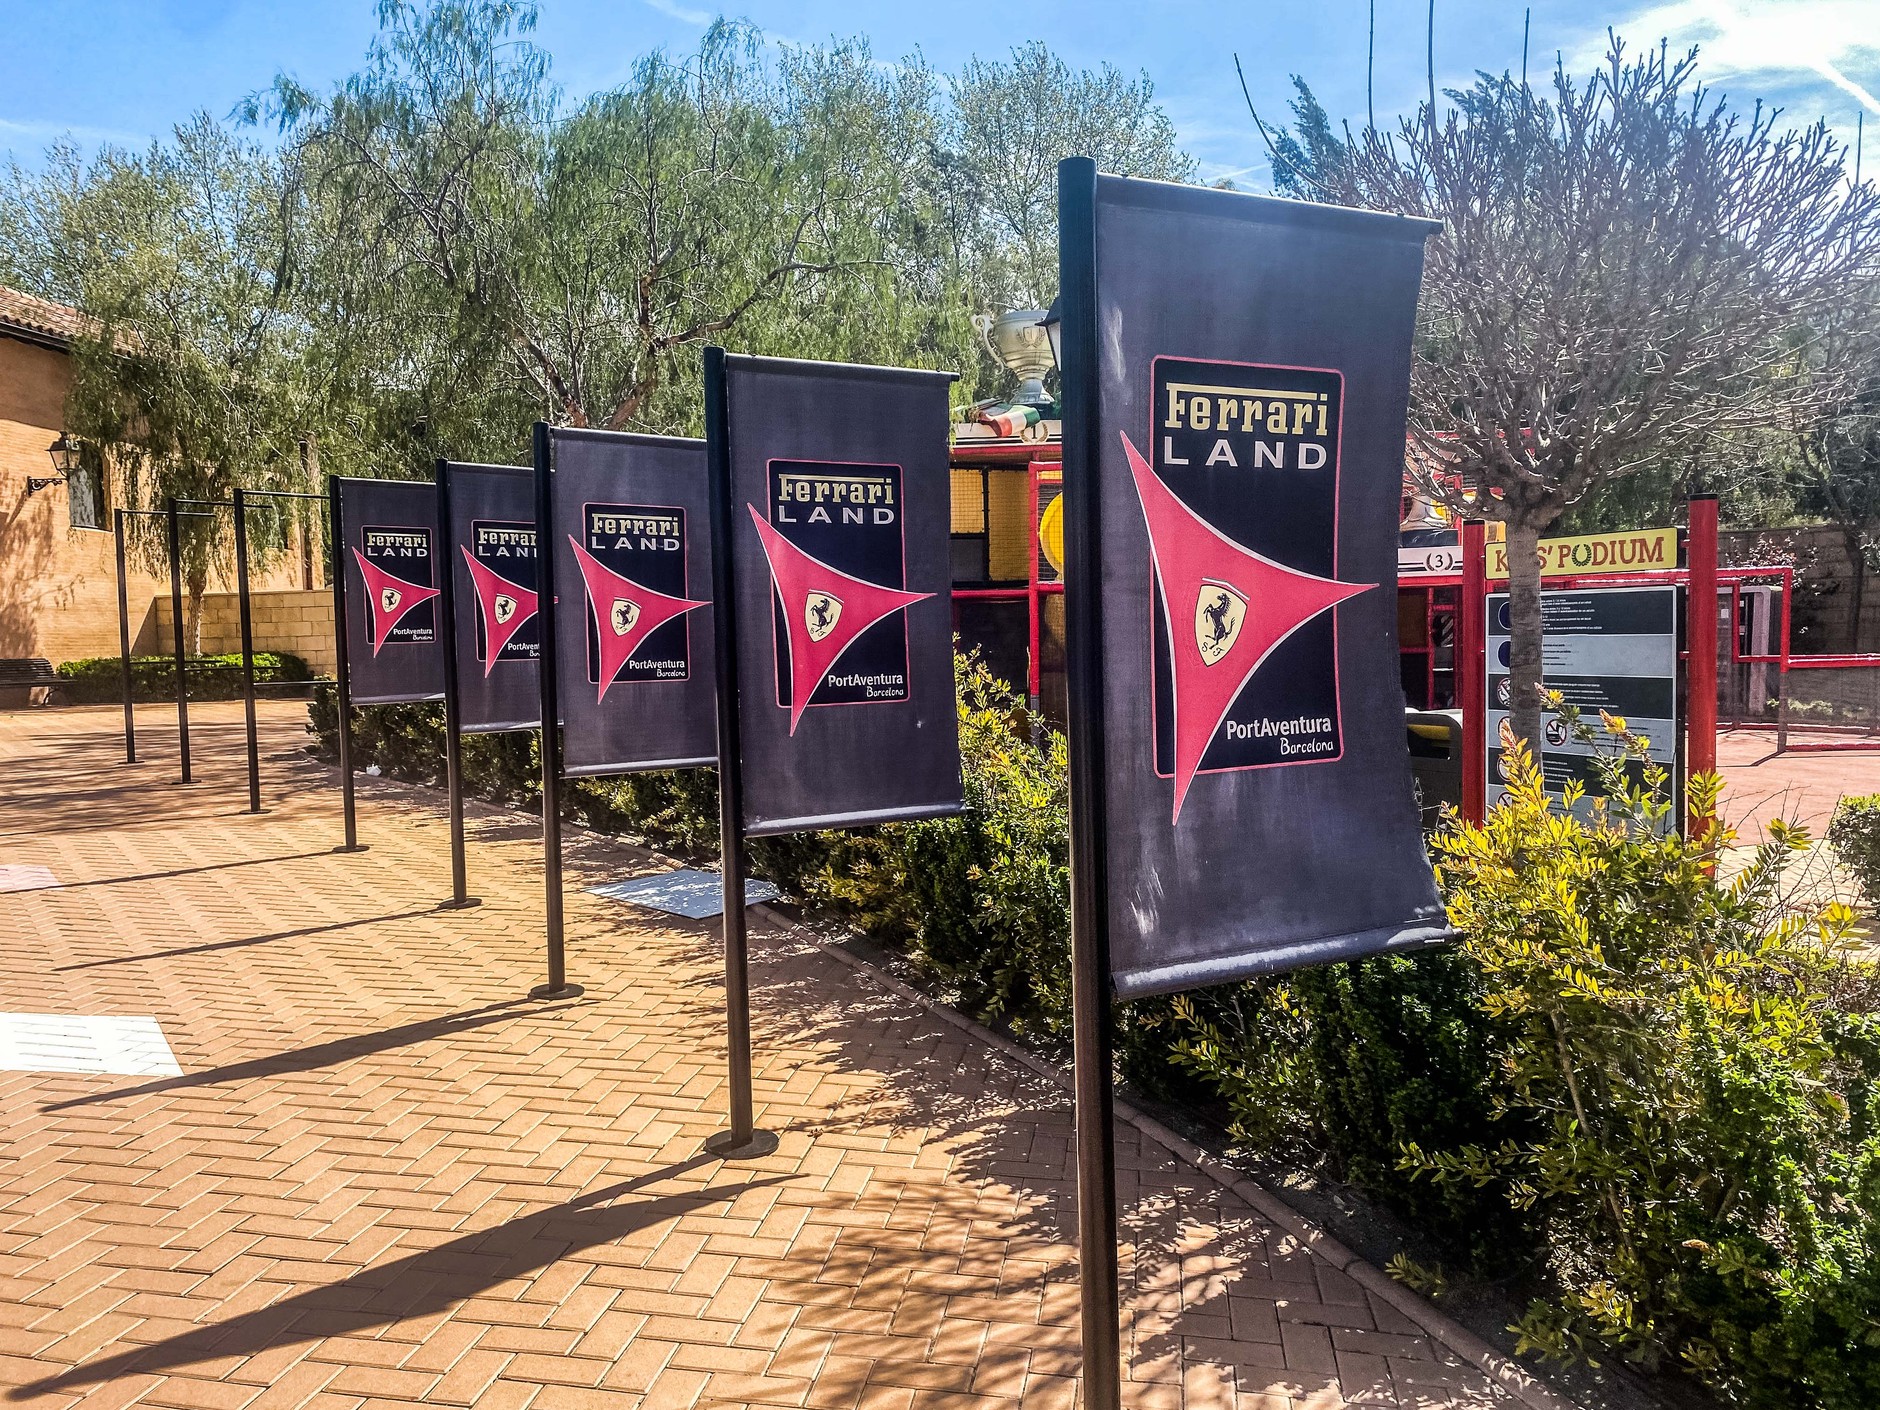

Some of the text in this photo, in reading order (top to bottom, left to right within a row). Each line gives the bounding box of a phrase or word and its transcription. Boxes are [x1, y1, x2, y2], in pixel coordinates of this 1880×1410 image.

[1164, 382, 1328, 436] Ferrari
[1164, 436, 1327, 470] LAND
[778, 474, 894, 505] Ferrari
[778, 505, 895, 524] LAND
[591, 513, 680, 536] Ferrari
[367, 532, 428, 548] Ferrari
[478, 528, 537, 546] Ferrar
[591, 536, 680, 551] LAND
[367, 547, 428, 557] LAND
[478, 545, 537, 558] LAN
[1495, 545, 1553, 572] KS'
[1435, 554, 1444, 568] 3
[507, 642, 540, 651] PortAven
[629, 660, 685, 669] PortAventura
[828, 673, 903, 687] PortAventura
[866, 686, 904, 697] Barcelona
[1226, 716, 1332, 739] PortAventura
[1280, 737, 1334, 755] Barcelona
